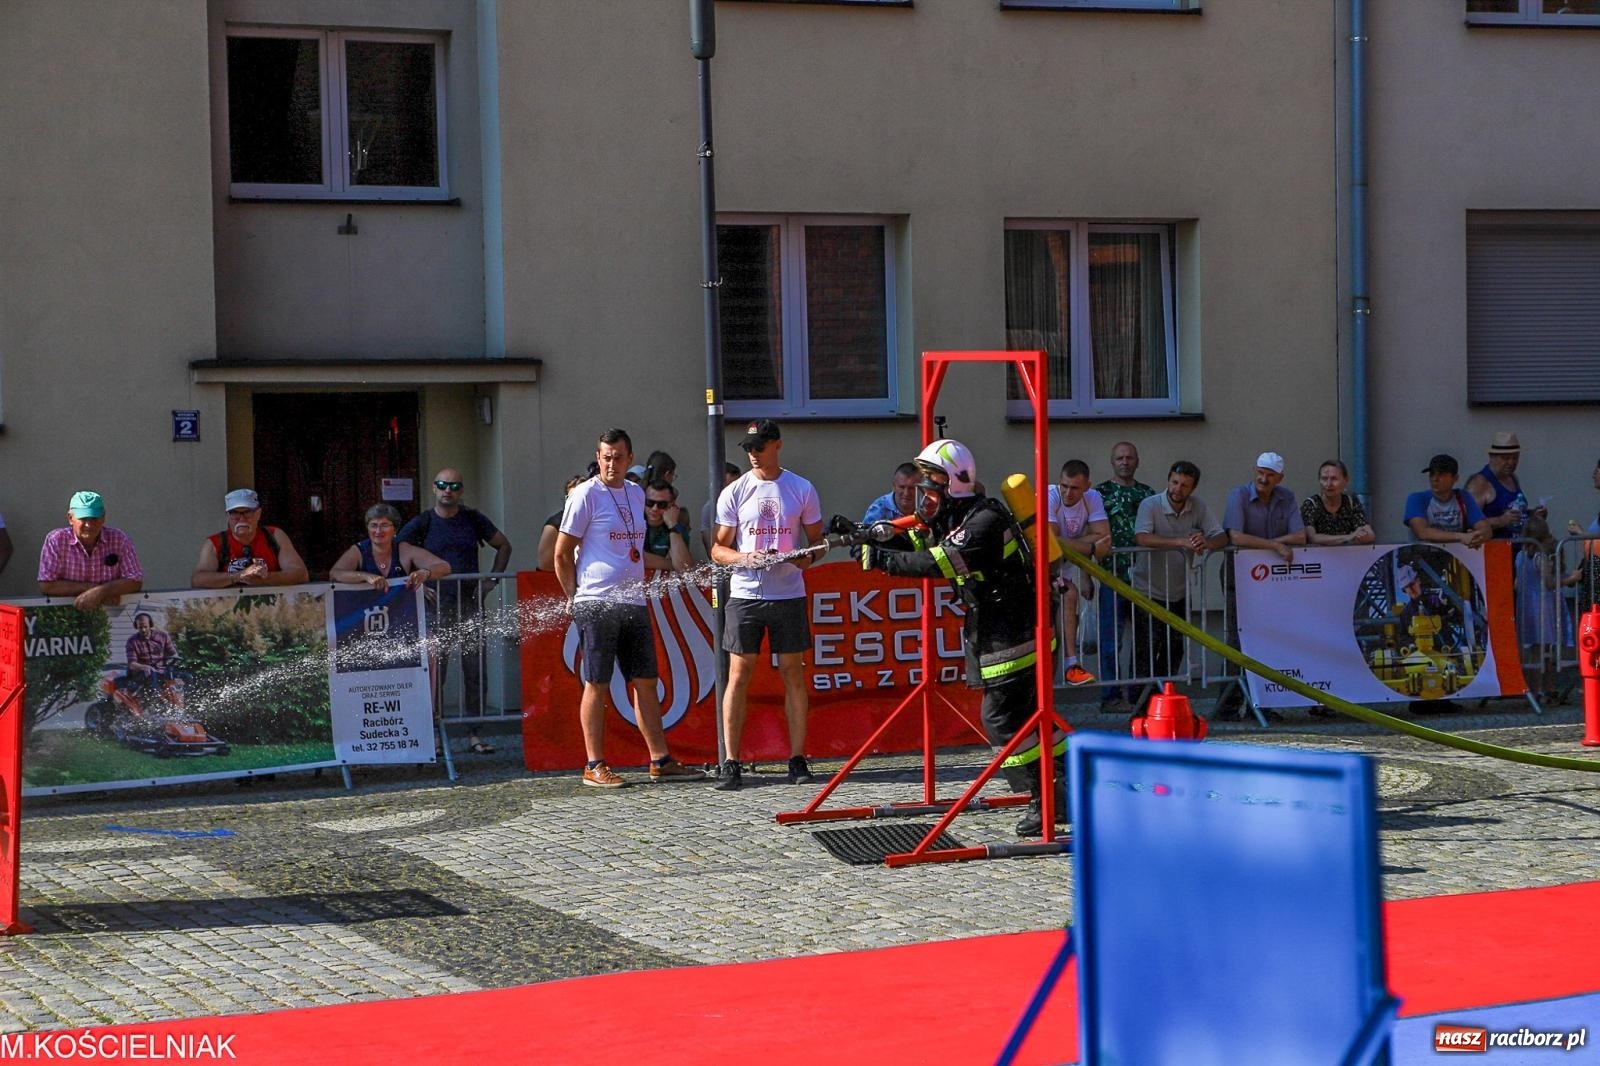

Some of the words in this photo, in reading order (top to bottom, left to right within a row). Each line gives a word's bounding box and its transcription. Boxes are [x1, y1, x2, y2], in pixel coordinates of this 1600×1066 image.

[180, 420, 192, 435] 2
[812, 586, 966, 624] EKOR
[24, 616, 37, 635] Y
[24, 635, 94, 658] VARNA
[812, 626, 966, 665] ESCU
[813, 672, 863, 690] SP.
[363, 700, 401, 715] RE-WI
[362, 716, 405, 728] Racibórz
[359, 728, 400, 740] Sudecka
[402, 727, 409, 737] 3
[352, 744, 365, 753] tel.
[366, 742, 378, 752] 32
[379, 741, 396, 751] 755
[397, 740, 407, 749] 18
[408, 739, 419, 748] 74
